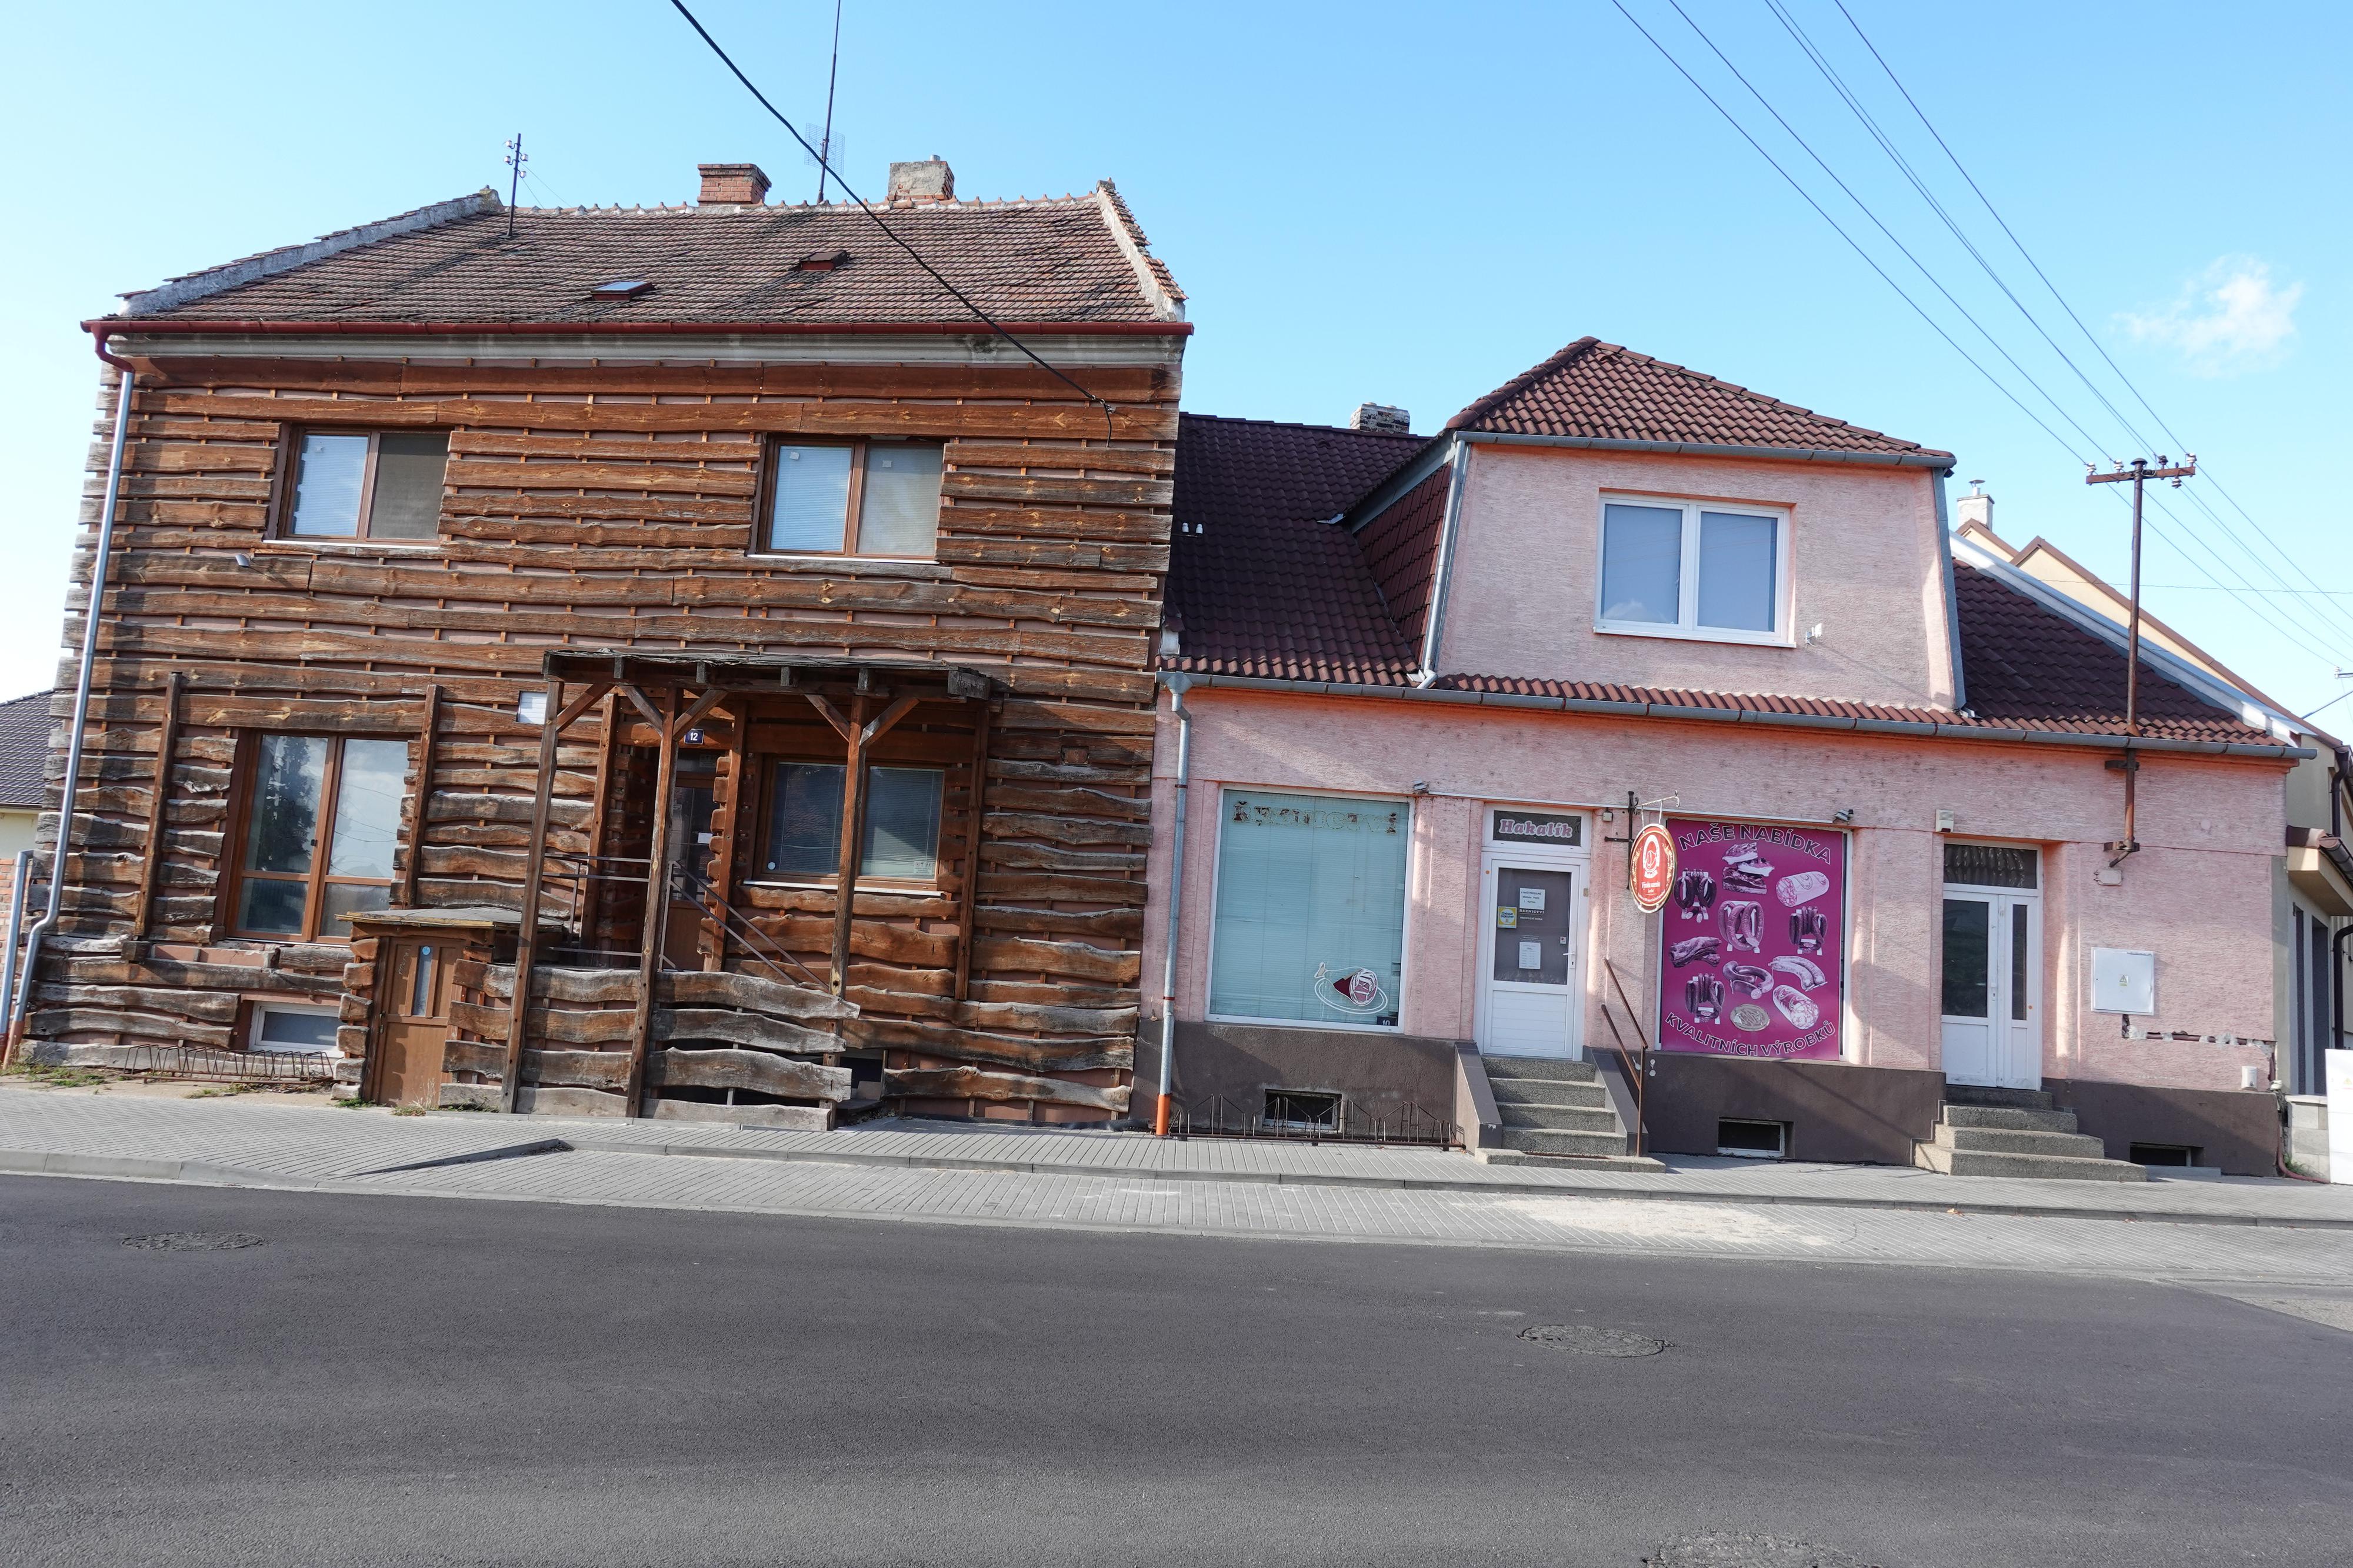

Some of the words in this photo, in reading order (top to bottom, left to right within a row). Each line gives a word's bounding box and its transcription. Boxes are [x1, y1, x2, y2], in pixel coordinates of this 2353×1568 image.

[691, 732, 698, 741] 12
[1499, 819, 1572, 838] Hakalík
[1678, 823, 1736, 850] NAŠE
[1740, 825, 1831, 865] NABÍDKA
[1665, 1012, 1758, 1056] KVALITNÍCH
[1760, 1020, 1835, 1056] VÝROBKŮ
